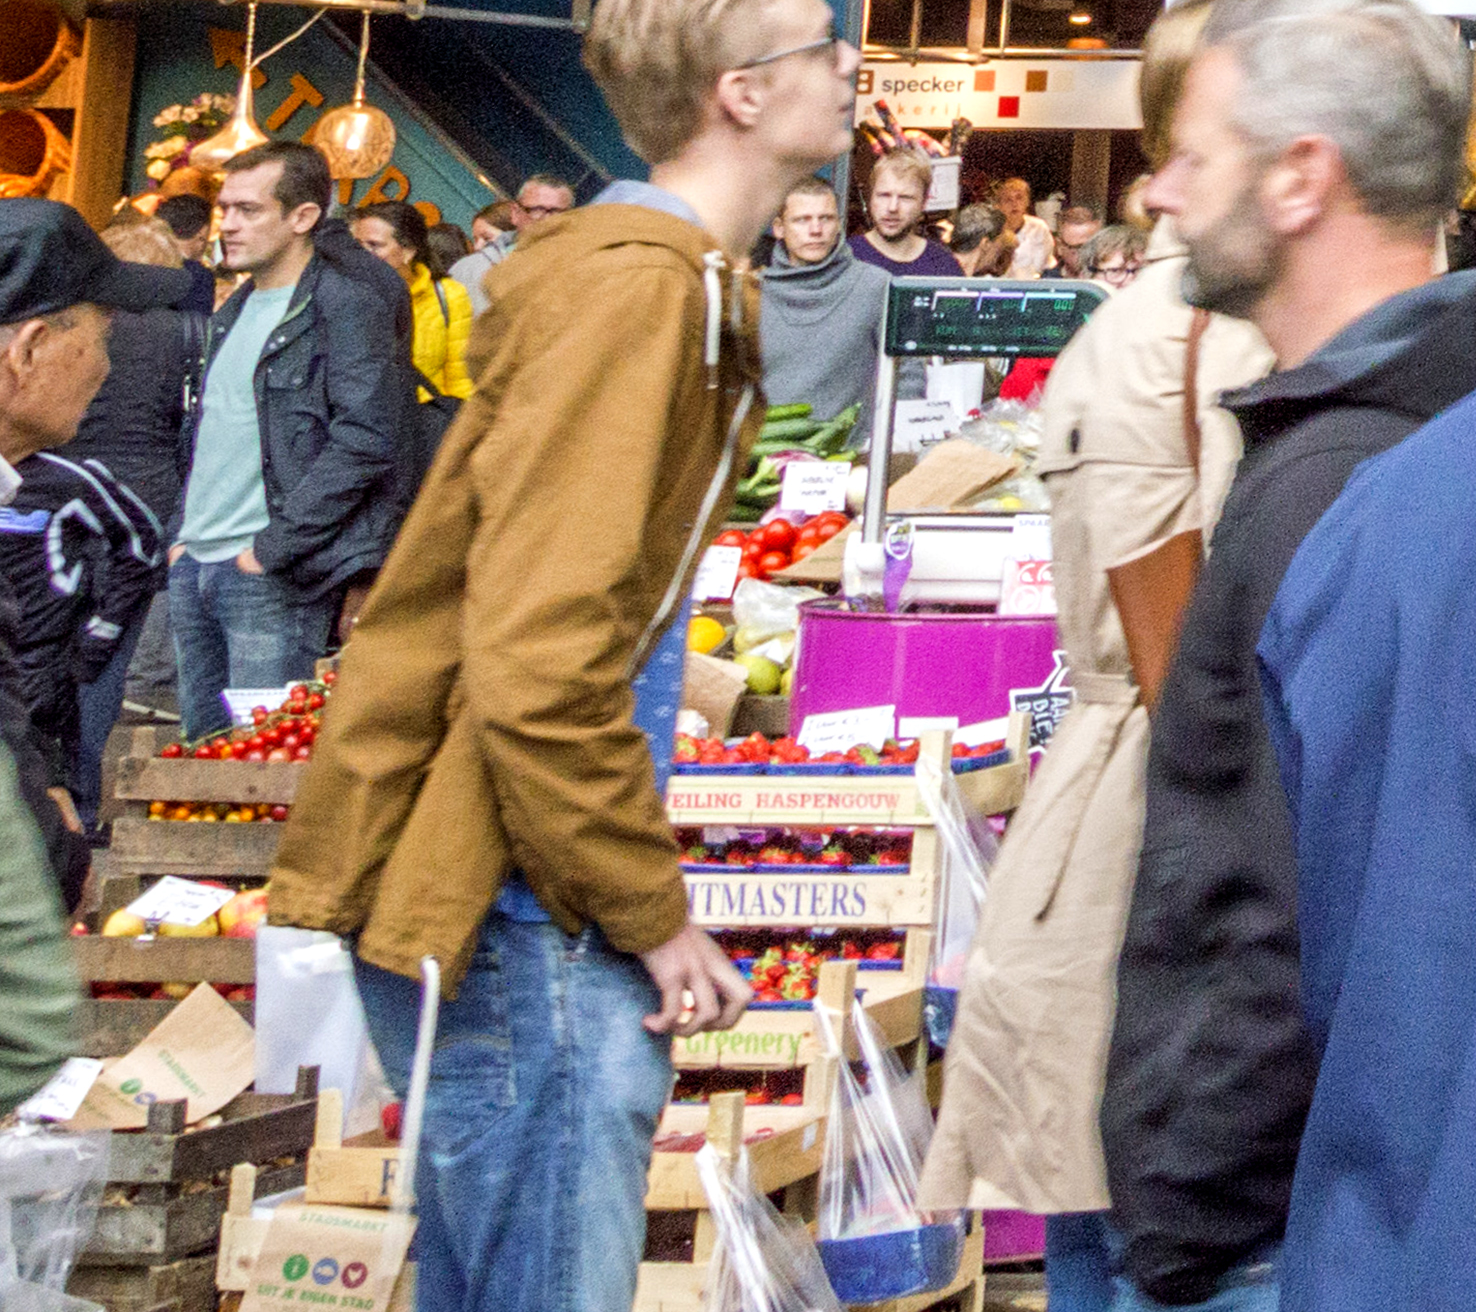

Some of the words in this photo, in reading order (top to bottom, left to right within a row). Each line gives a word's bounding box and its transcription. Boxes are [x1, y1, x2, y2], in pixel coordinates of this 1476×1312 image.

[882, 76, 965, 97] specker
[755, 792, 901, 811] HASPENGOUW
[687, 881, 867, 920] ITMASTERS
